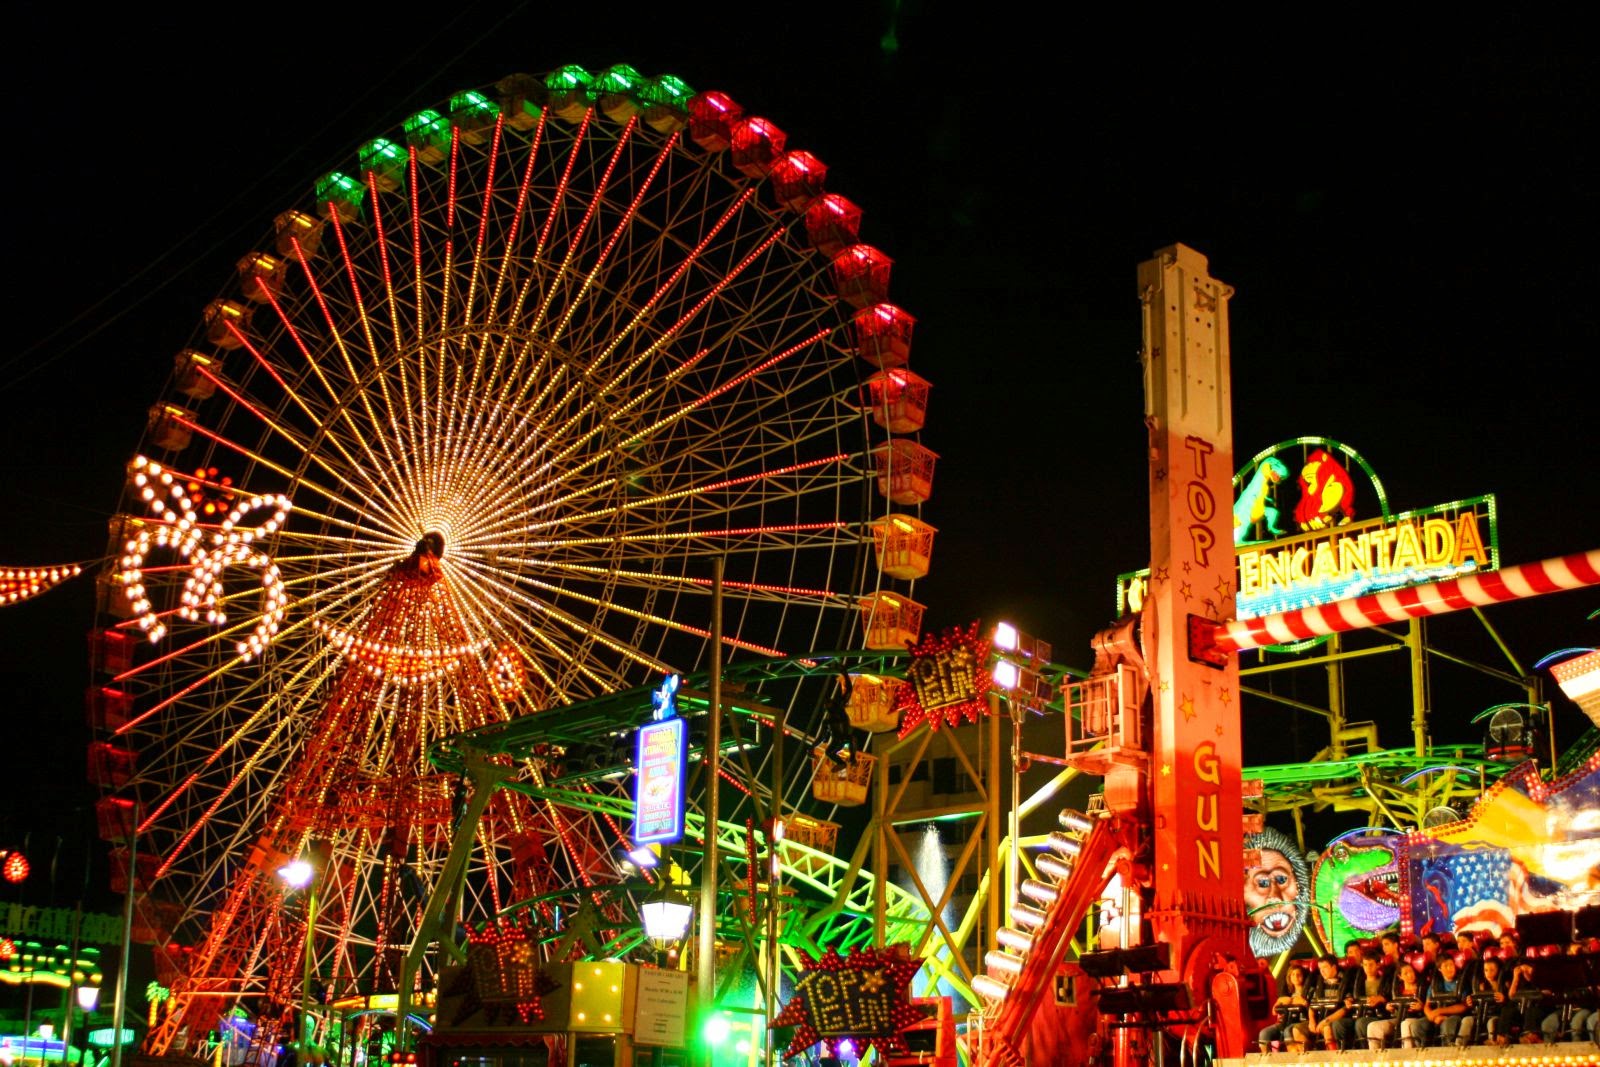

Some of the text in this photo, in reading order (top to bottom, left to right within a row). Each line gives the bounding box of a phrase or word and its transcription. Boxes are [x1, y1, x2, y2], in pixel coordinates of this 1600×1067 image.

[1239, 511, 1488, 596] ENCANTADA
[1185, 435, 1221, 880] TOP GUN
[795, 968, 858, 1031] TOP
